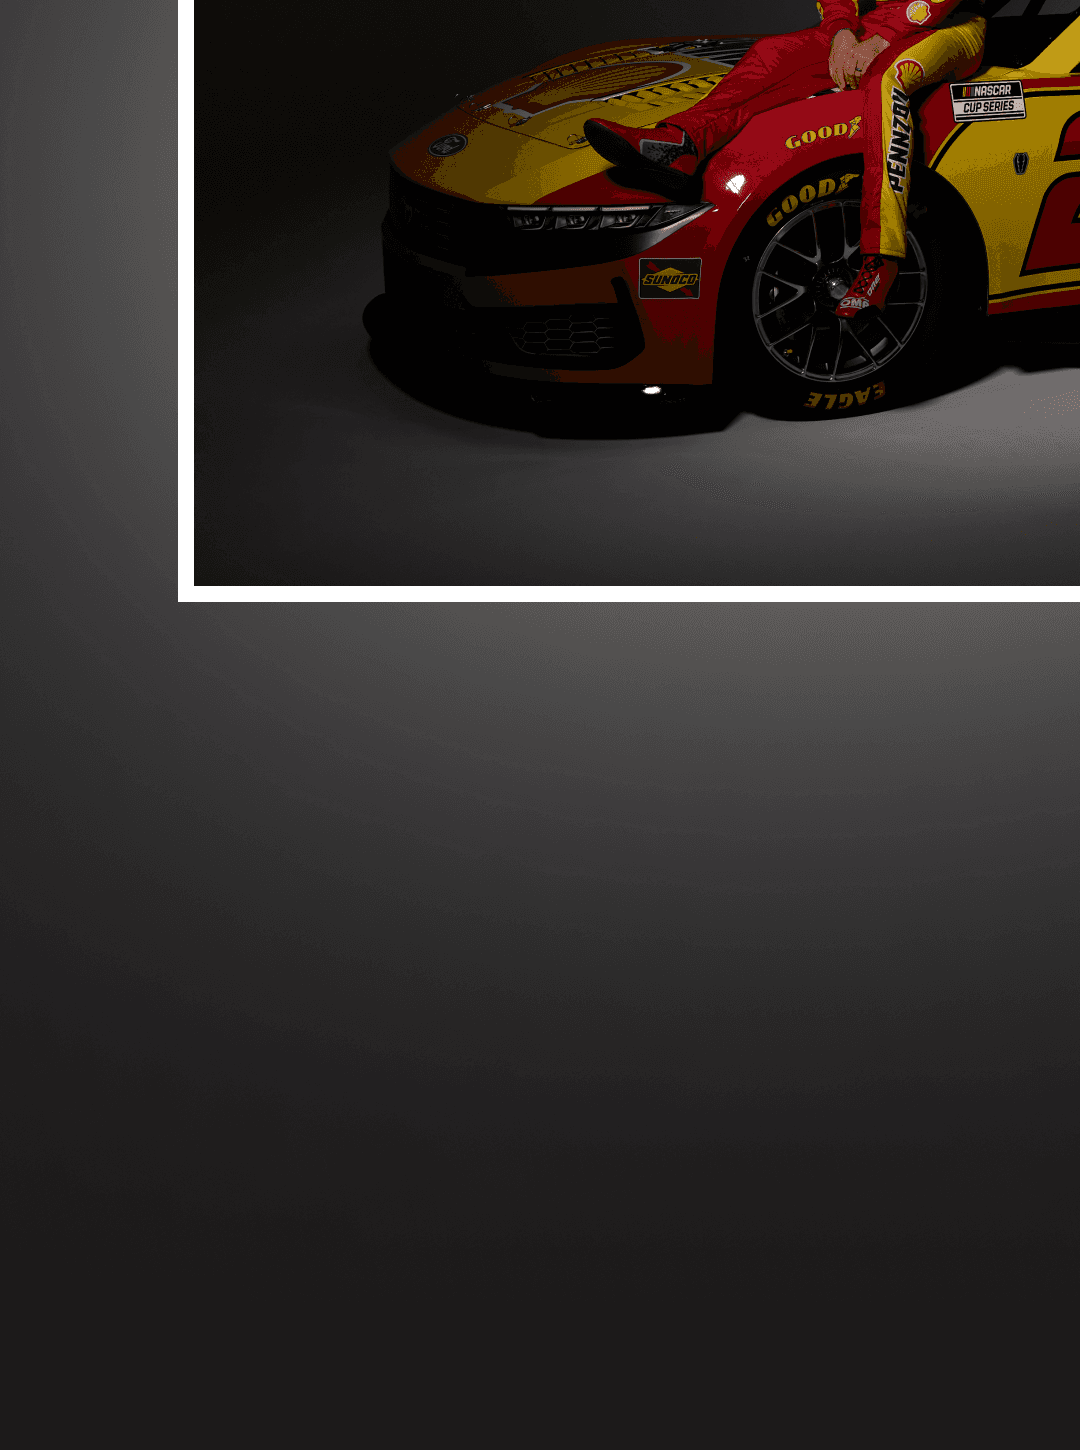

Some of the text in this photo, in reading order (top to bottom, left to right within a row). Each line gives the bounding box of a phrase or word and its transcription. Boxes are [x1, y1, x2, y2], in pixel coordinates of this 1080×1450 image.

[974, 84, 1012, 97] NASCAR
[963, 101, 1015, 113] CUP SERIES
[887, 86, 910, 194] PENNZOIL
[642, 274, 698, 286] SUNOCO
[840, 297, 870, 309] OMP
[804, 380, 886, 410] EAGLE
